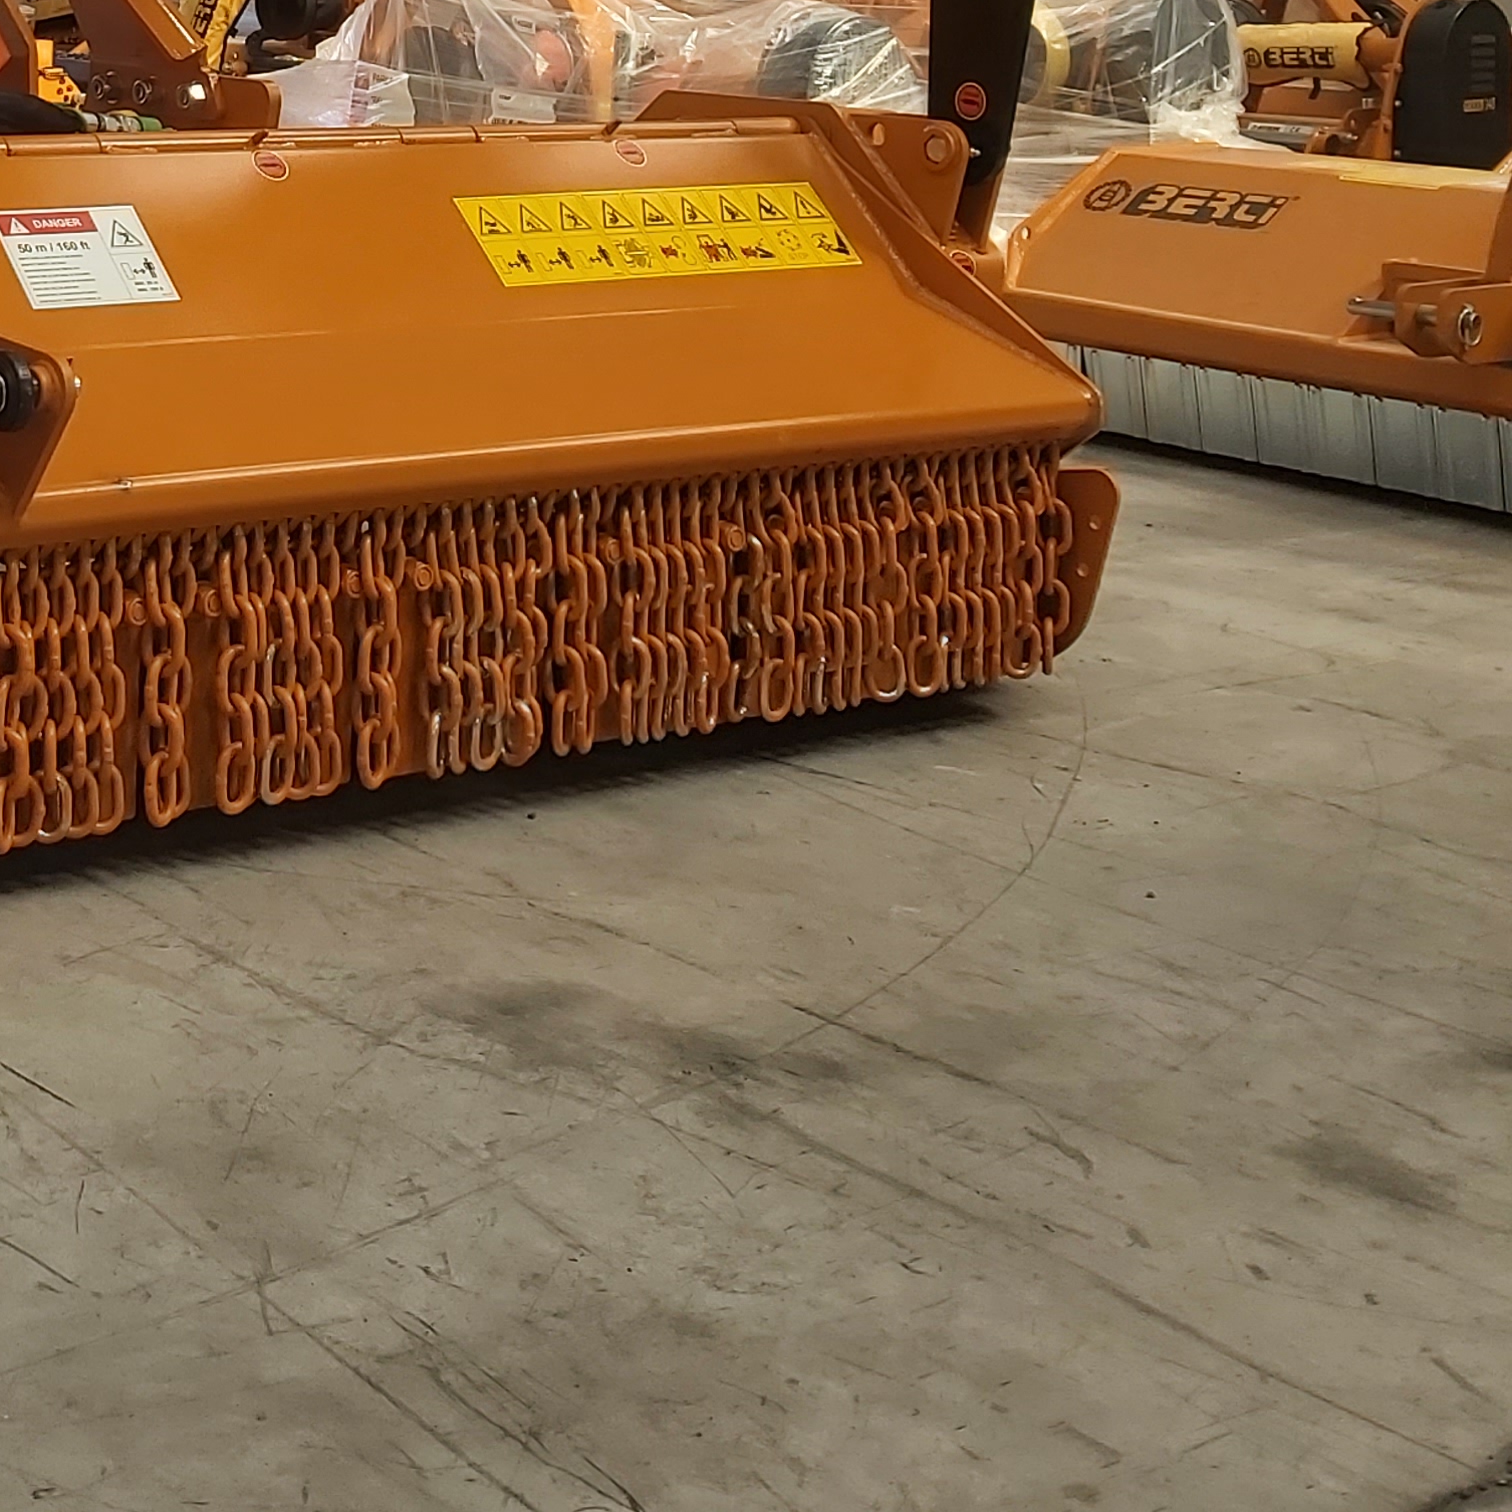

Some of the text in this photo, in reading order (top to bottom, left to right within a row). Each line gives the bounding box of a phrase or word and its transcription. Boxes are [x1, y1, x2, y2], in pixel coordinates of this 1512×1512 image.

[1263, 47, 1336, 68] BERTI
[1121, 184, 1289, 229] BERTI
[31, 216, 83, 229] DANGER
[17, 243, 33, 254] 50
[56, 240, 78, 251] 160
